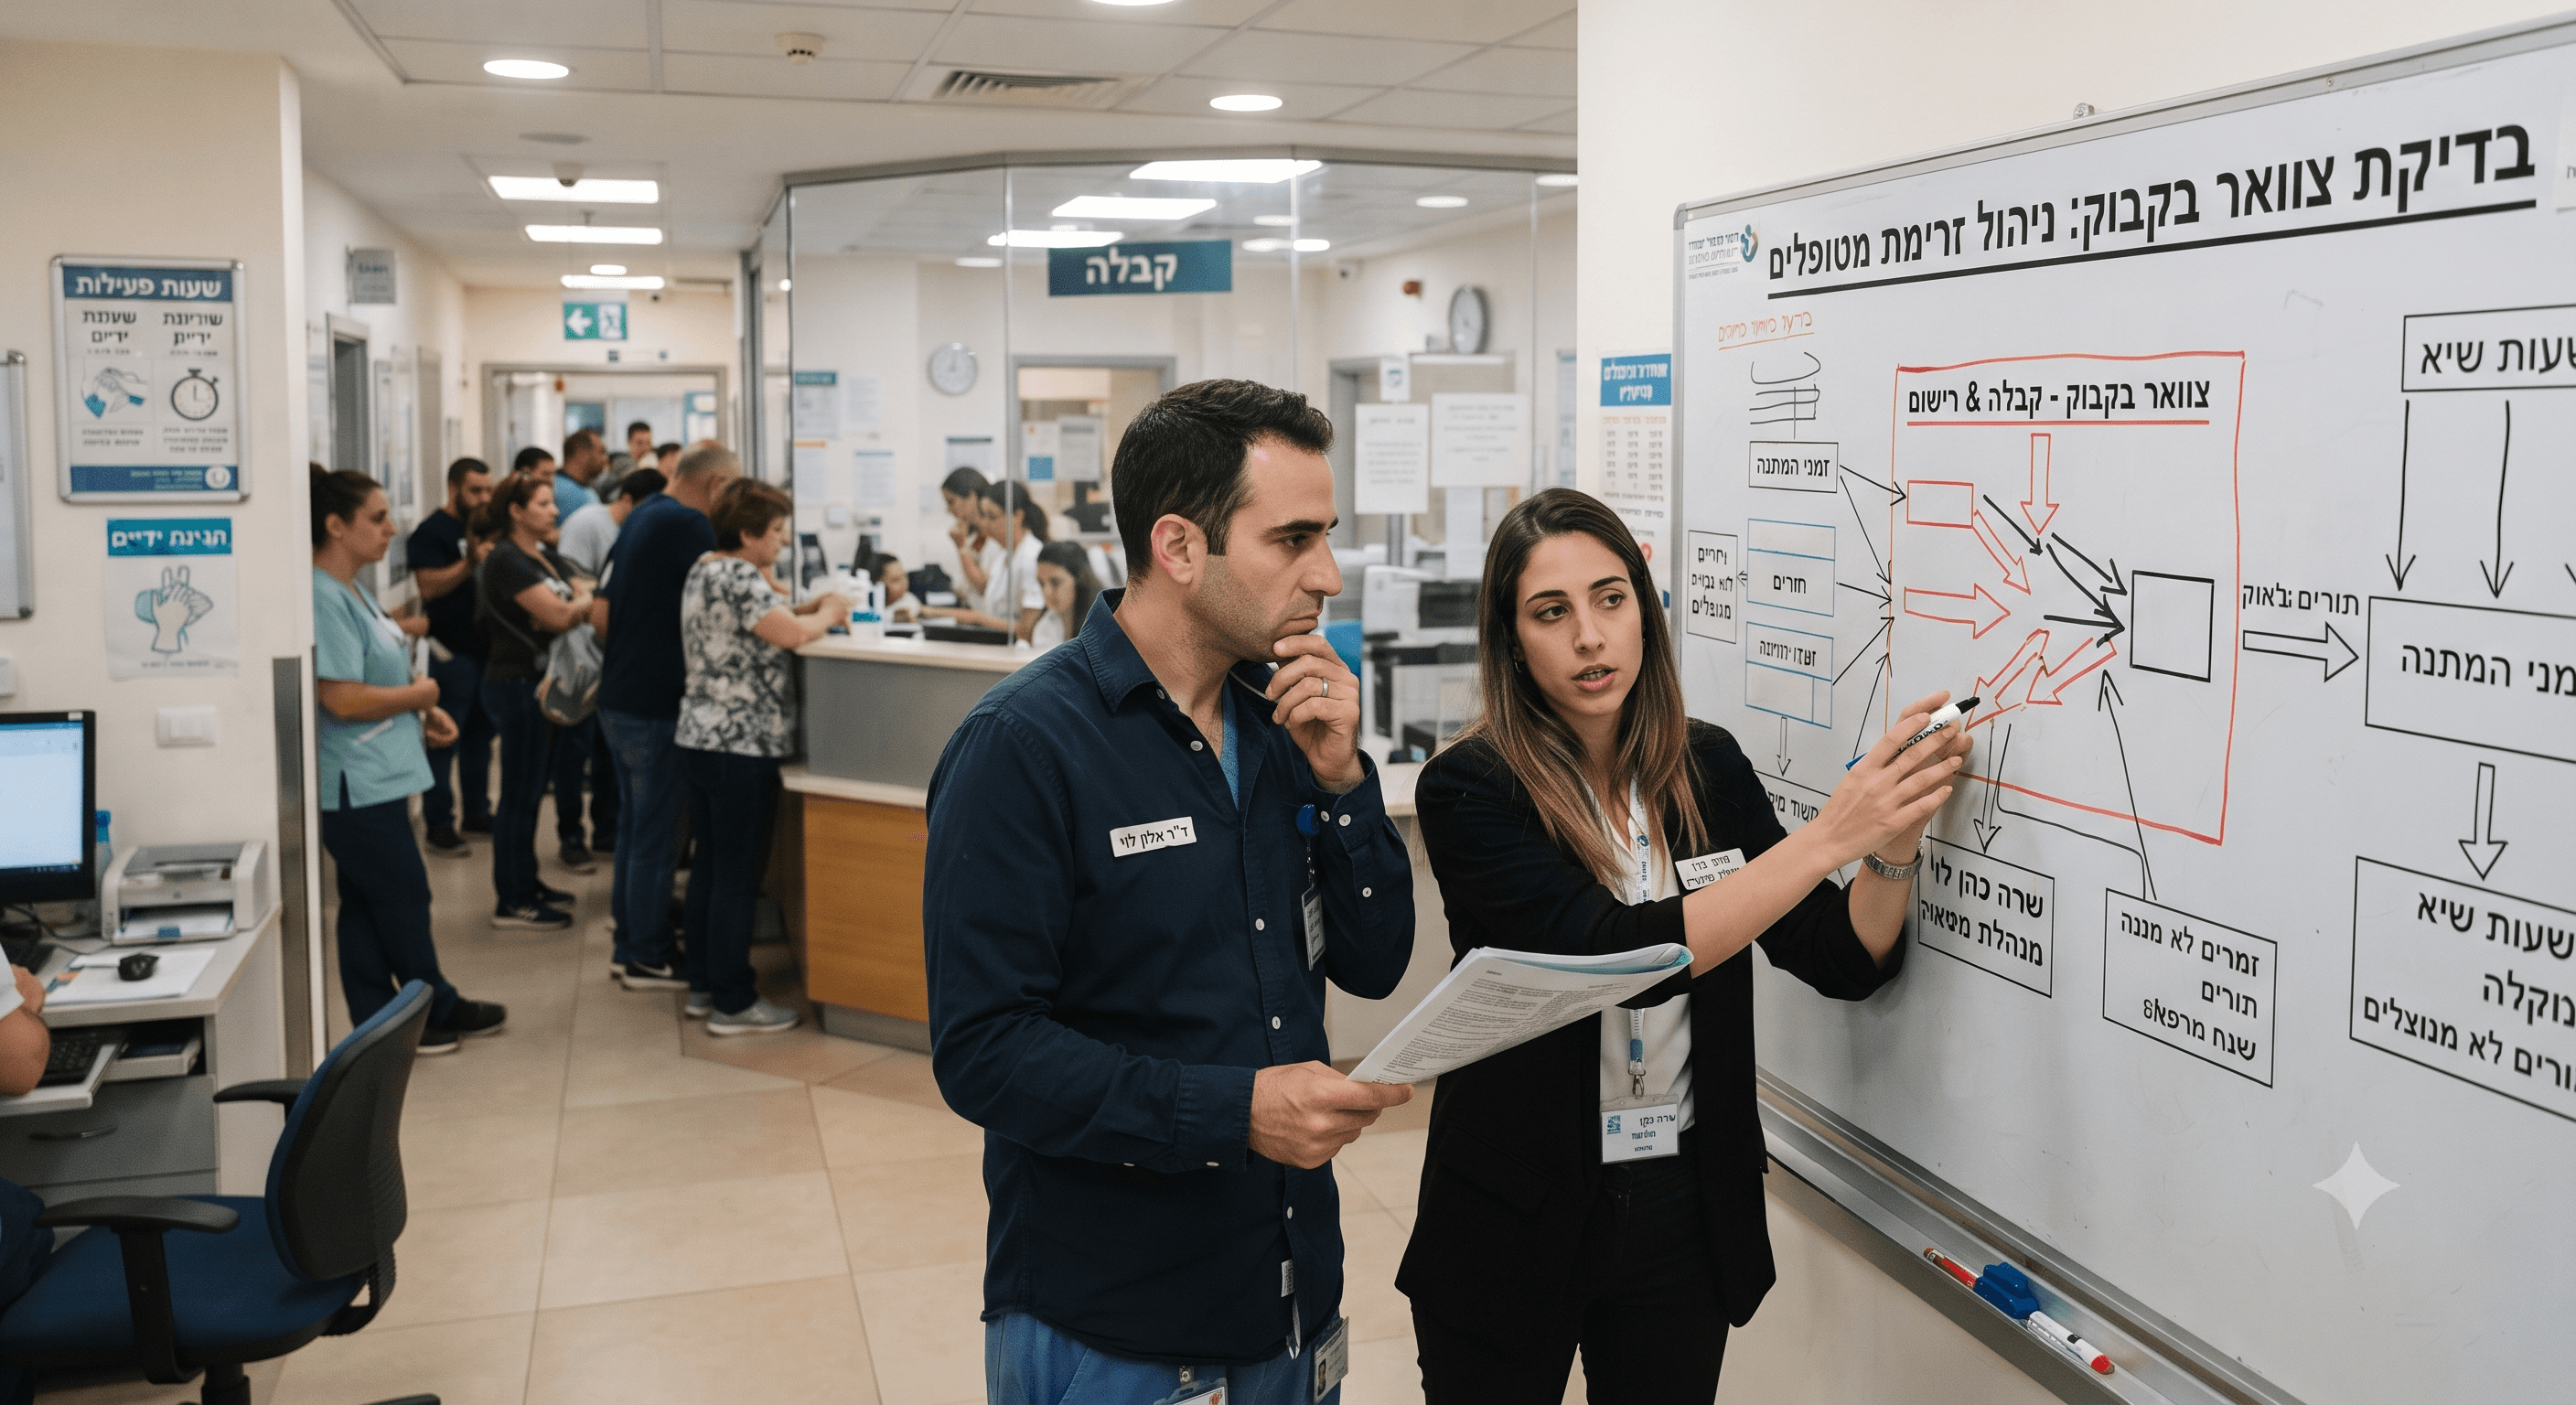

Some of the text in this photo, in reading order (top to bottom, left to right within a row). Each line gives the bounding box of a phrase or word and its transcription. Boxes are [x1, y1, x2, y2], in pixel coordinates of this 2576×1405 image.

[1769, 124, 2536, 280] בדיקת צוואר בקבוק: ניהול זרימת מטופלים
[76, 272, 222, 299] שעות פעילות
[1086, 246, 1177, 292] קבלה
[2420, 340, 2485, 374] שיא
[1908, 390, 1959, 413] רישום
[1988, 379, 2043, 420] קבלה
[2066, 383, 2136, 420] בקבוק
[2144, 381, 2210, 409] צוואר
[1757, 457, 1830, 477] זמני המתנה
[2401, 644, 2511, 688] המתנה
[1119, 833, 1136, 849] לוי
[1140, 830, 1165, 849] אלון
[1959, 869, 1991, 901] כהן
[1998, 883, 2044, 918] שרה
[1977, 918, 2044, 967] מנהלת
[2170, 925, 2195, 955] לא
[2418, 892, 2575, 960] שעות שיא
[2201, 939, 2259, 978] זמרים
[2201, 980, 2258, 1019] תורים
[2364, 995, 2576, 1093] ורים לא מנוצלים
